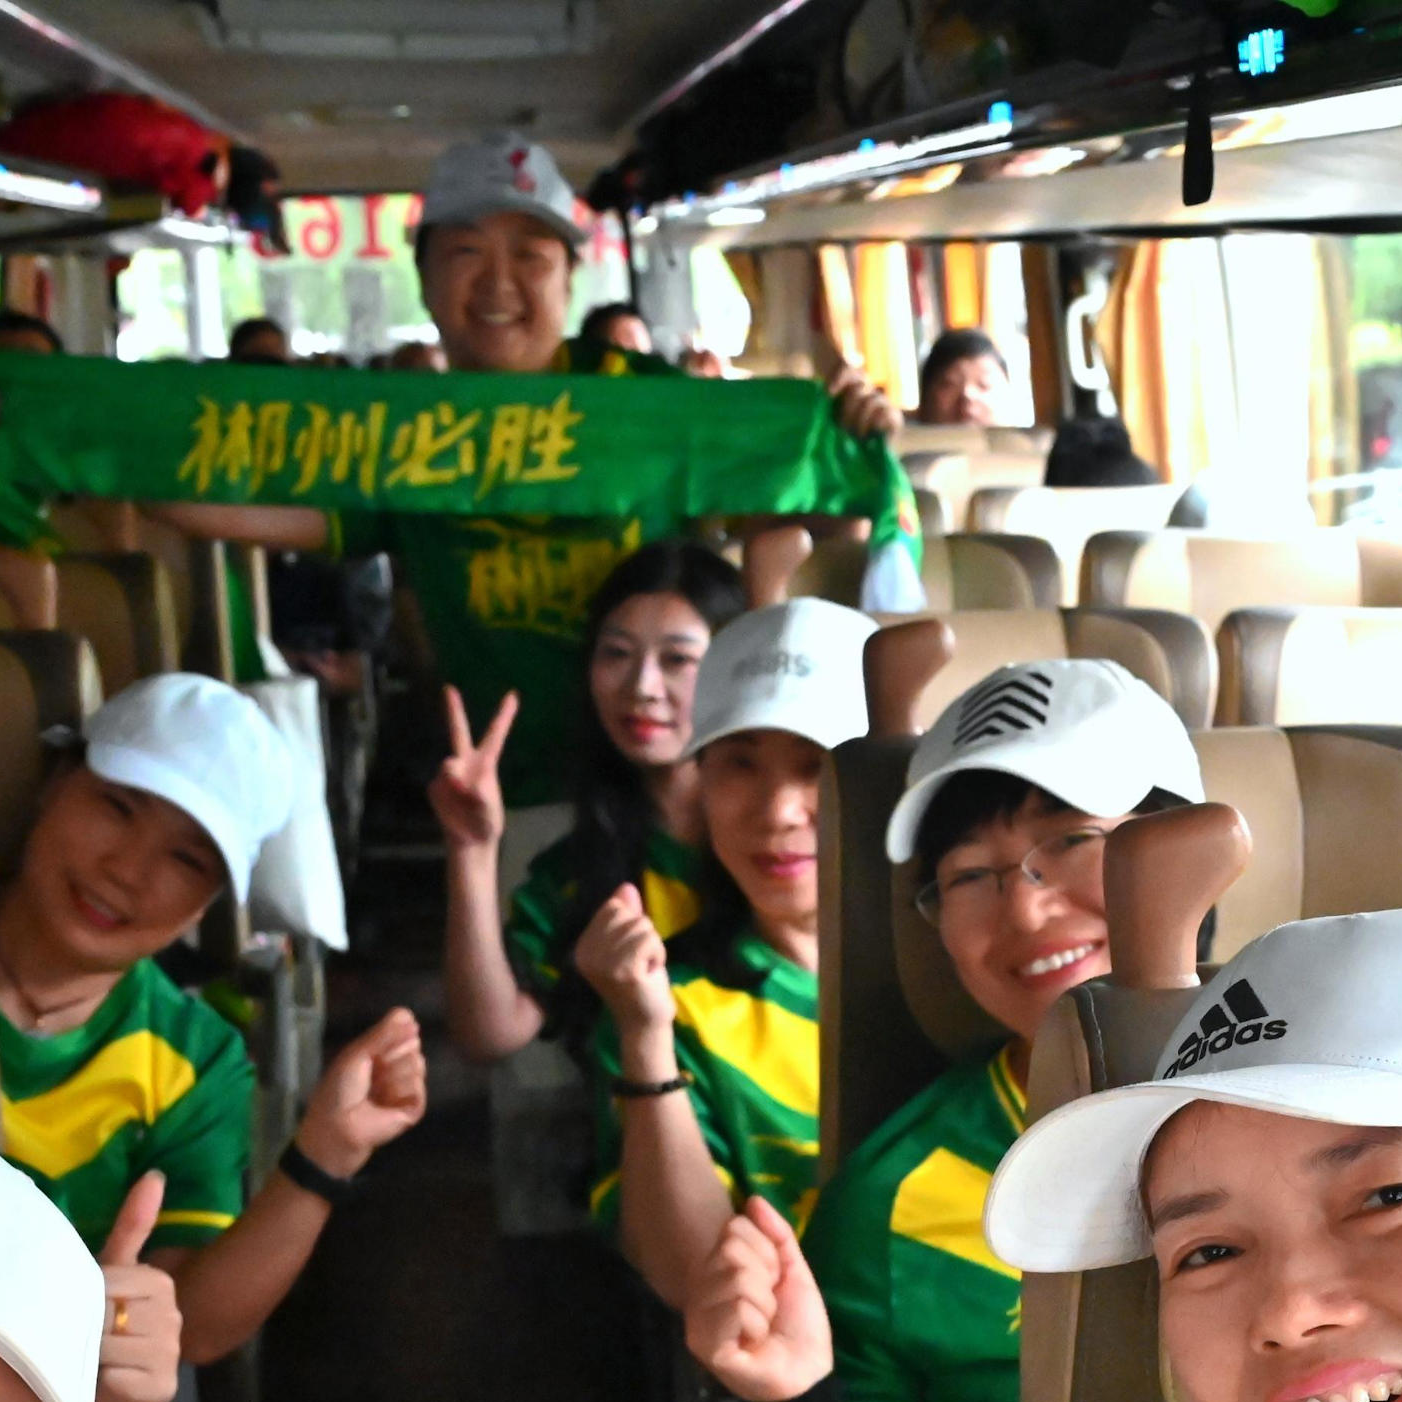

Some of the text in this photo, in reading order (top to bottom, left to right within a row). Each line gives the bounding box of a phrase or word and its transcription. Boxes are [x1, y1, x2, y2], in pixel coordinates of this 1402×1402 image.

[177, 391, 584, 499] 郴州必胜
[1162, 1016, 1289, 1080] adidas
